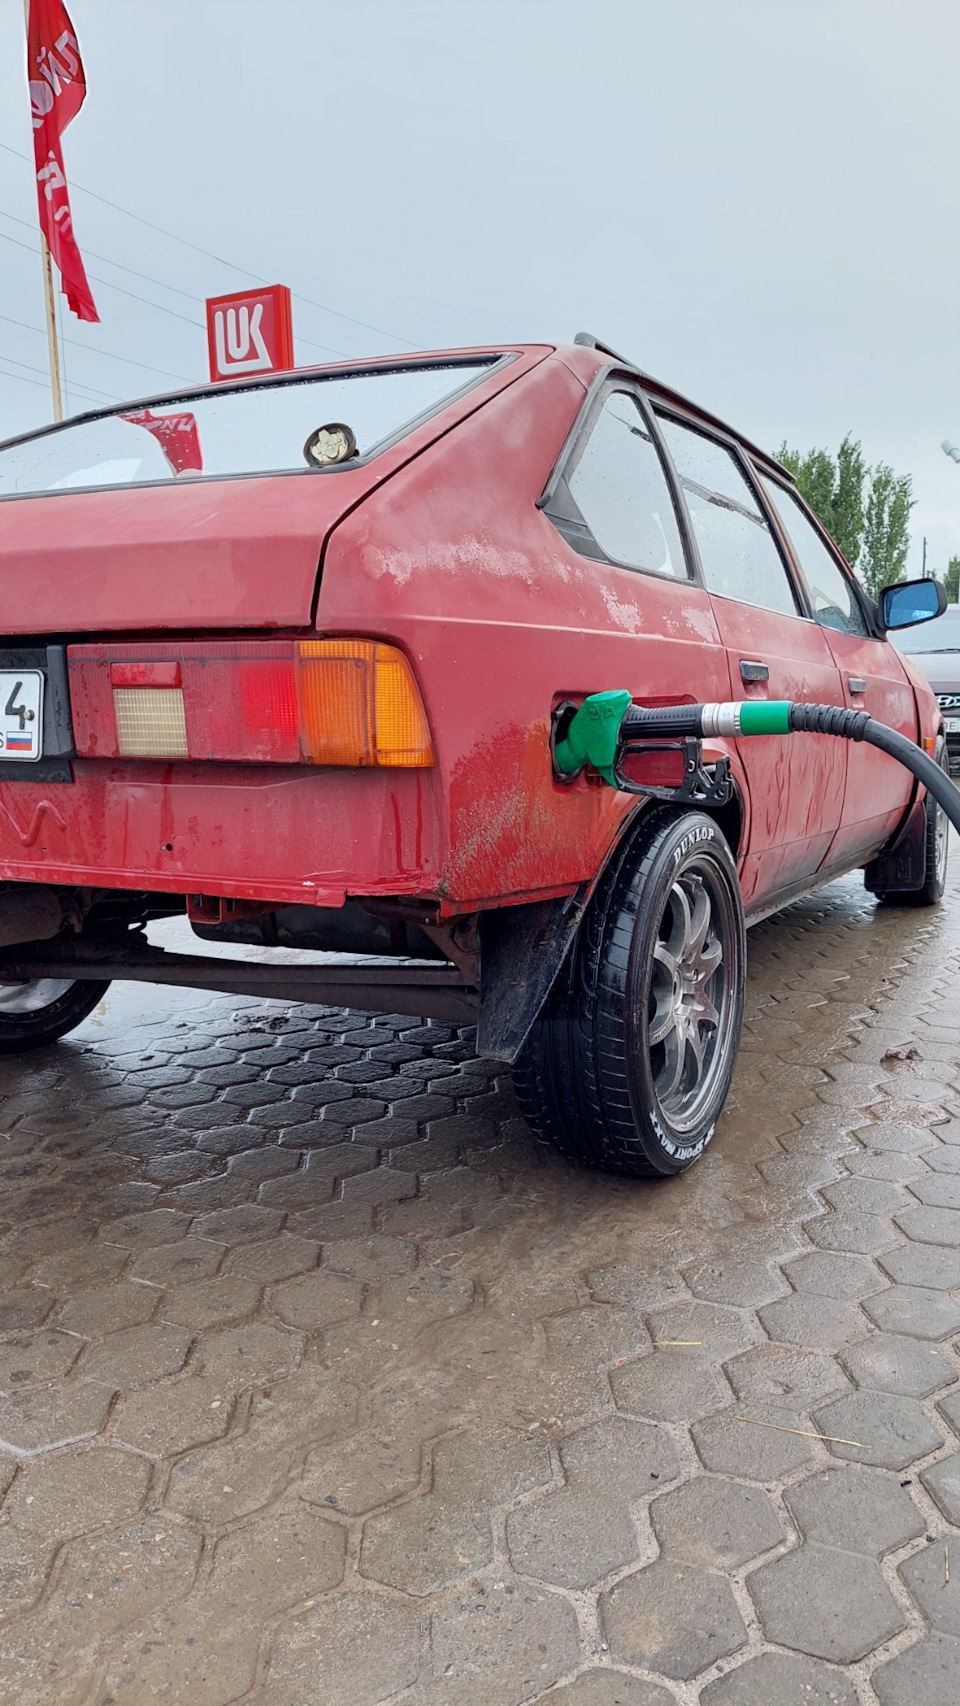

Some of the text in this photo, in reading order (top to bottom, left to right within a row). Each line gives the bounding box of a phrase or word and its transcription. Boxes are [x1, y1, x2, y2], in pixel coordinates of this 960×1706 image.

[673, 828, 715, 865] DUNLOP
[649, 1109, 676, 1156] MAXX
[674, 1141, 705, 1160] SPORT
